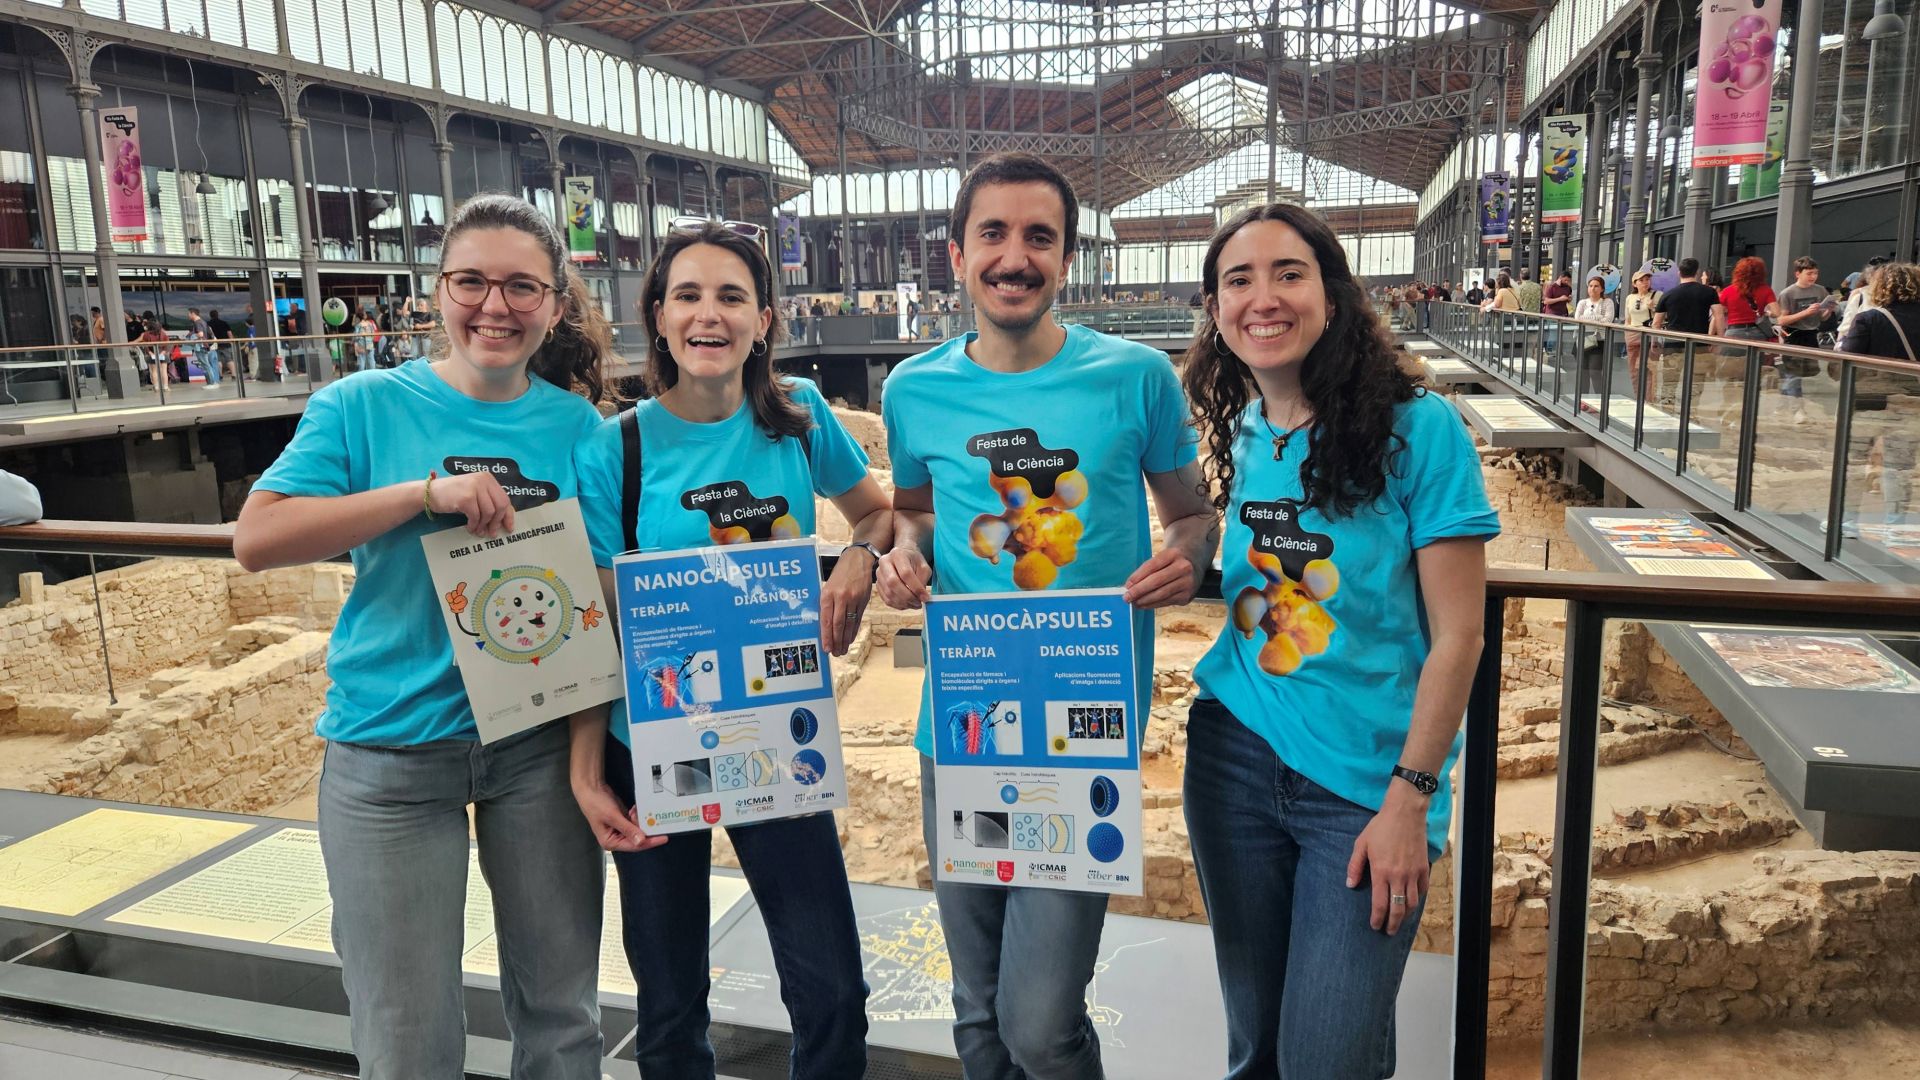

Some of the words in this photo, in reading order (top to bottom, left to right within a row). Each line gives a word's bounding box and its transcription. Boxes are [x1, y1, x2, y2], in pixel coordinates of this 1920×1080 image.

[976, 437, 1009, 450] Festa
[1011, 434, 1027, 446] de
[454, 461, 490, 472] Festa
[492, 462, 508, 474] de
[1002, 460, 1014, 471] la
[1016, 456, 1064, 470] Ciència
[690, 489, 722, 505] Festa
[723, 486, 738, 498] de
[720, 512, 732, 523] la
[733, 504, 776, 520] Ciència
[1245, 506, 1274, 520] Festa
[1274, 508, 1289, 520] de
[449, 546, 471, 559] CREA
[472, 543, 483, 553] LA
[484, 538, 505, 550] TEVA
[1261, 534, 1271, 547] la
[1273, 535, 1318, 552] Ciència
[734, 588, 810, 606] DIAGNOSIS
[630, 602, 690, 618] TERÀPIA
[943, 608, 1113, 632] NANOCÀPSULES
[939, 644, 996, 659] TERÀPIA
[1039, 644, 1120, 657] DIAGNOSIS
[743, 795, 774, 806] ICMAB
[821, 791, 835, 799] BBN
[953, 859, 994, 869] nanomol
[1036, 863, 1067, 872] ICMAB
[1087, 869, 1113, 881] ciber
